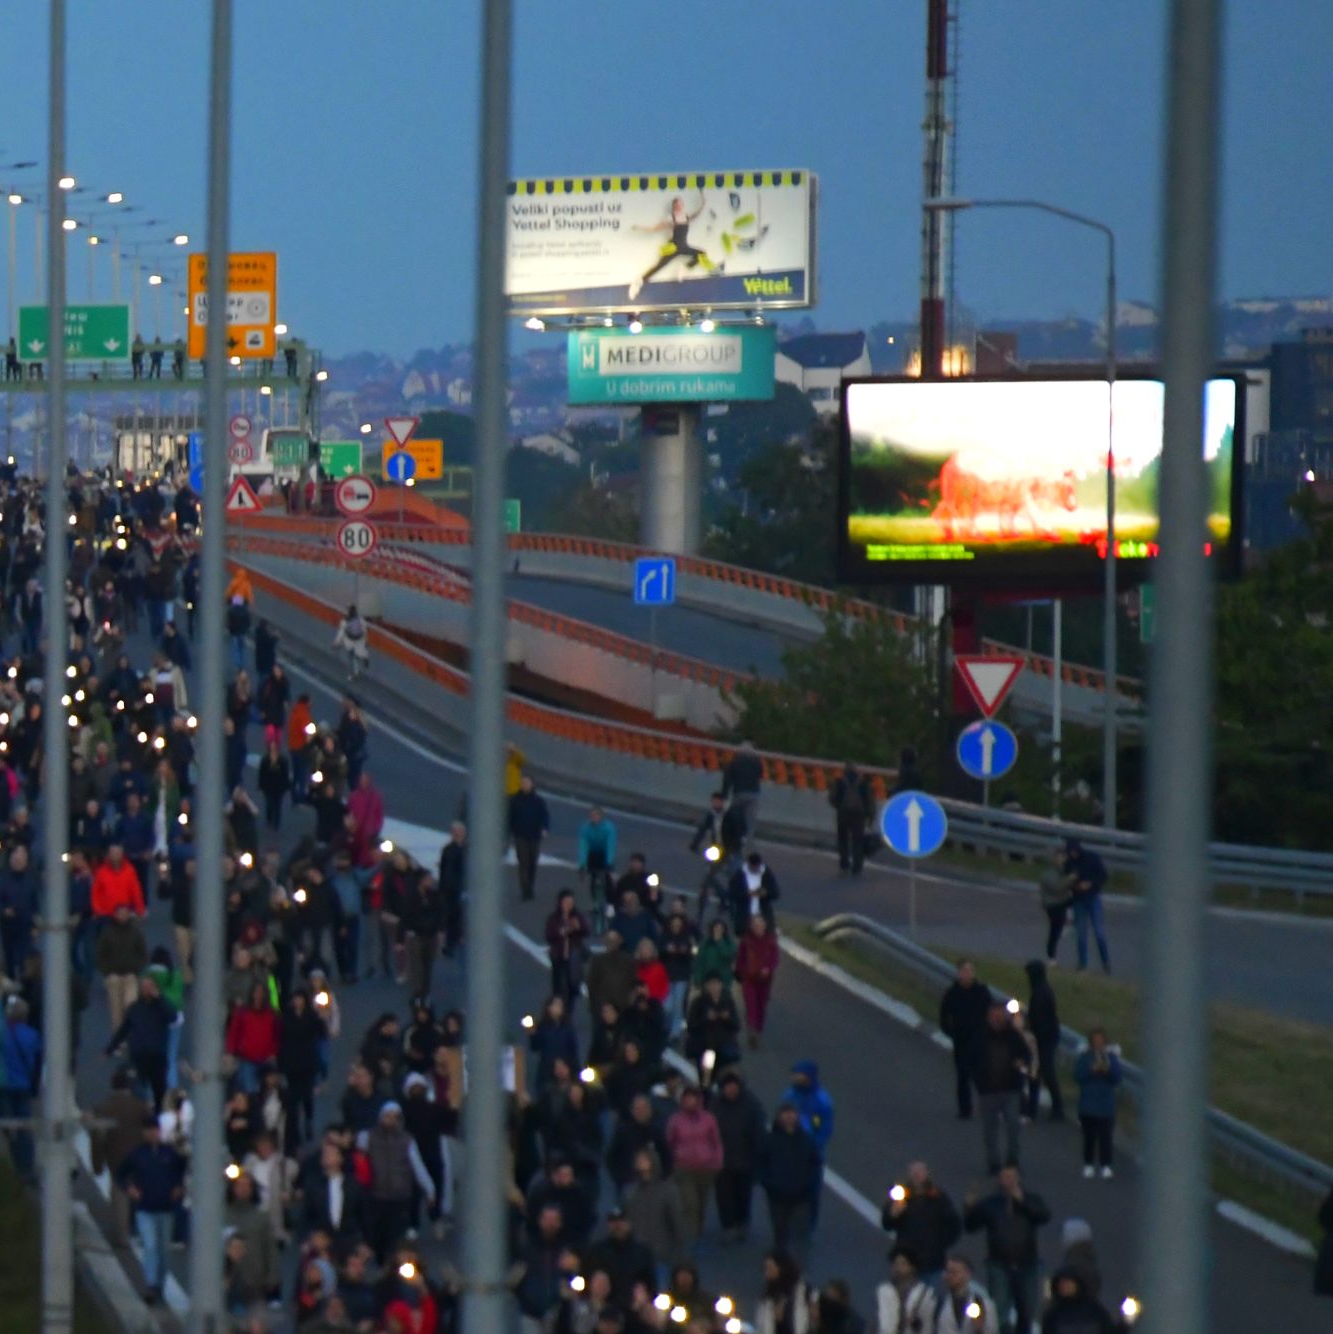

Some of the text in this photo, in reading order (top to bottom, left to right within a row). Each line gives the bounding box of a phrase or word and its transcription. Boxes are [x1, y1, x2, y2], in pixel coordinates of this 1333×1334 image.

[512, 202, 622, 216] Veliki popusti uz
[513, 216, 621, 231] Yettel Shopping
[607, 344, 737, 365] MEDIGROUP
[606, 377, 736, 395] U dobrim rukama
[344, 528, 370, 549] 80
